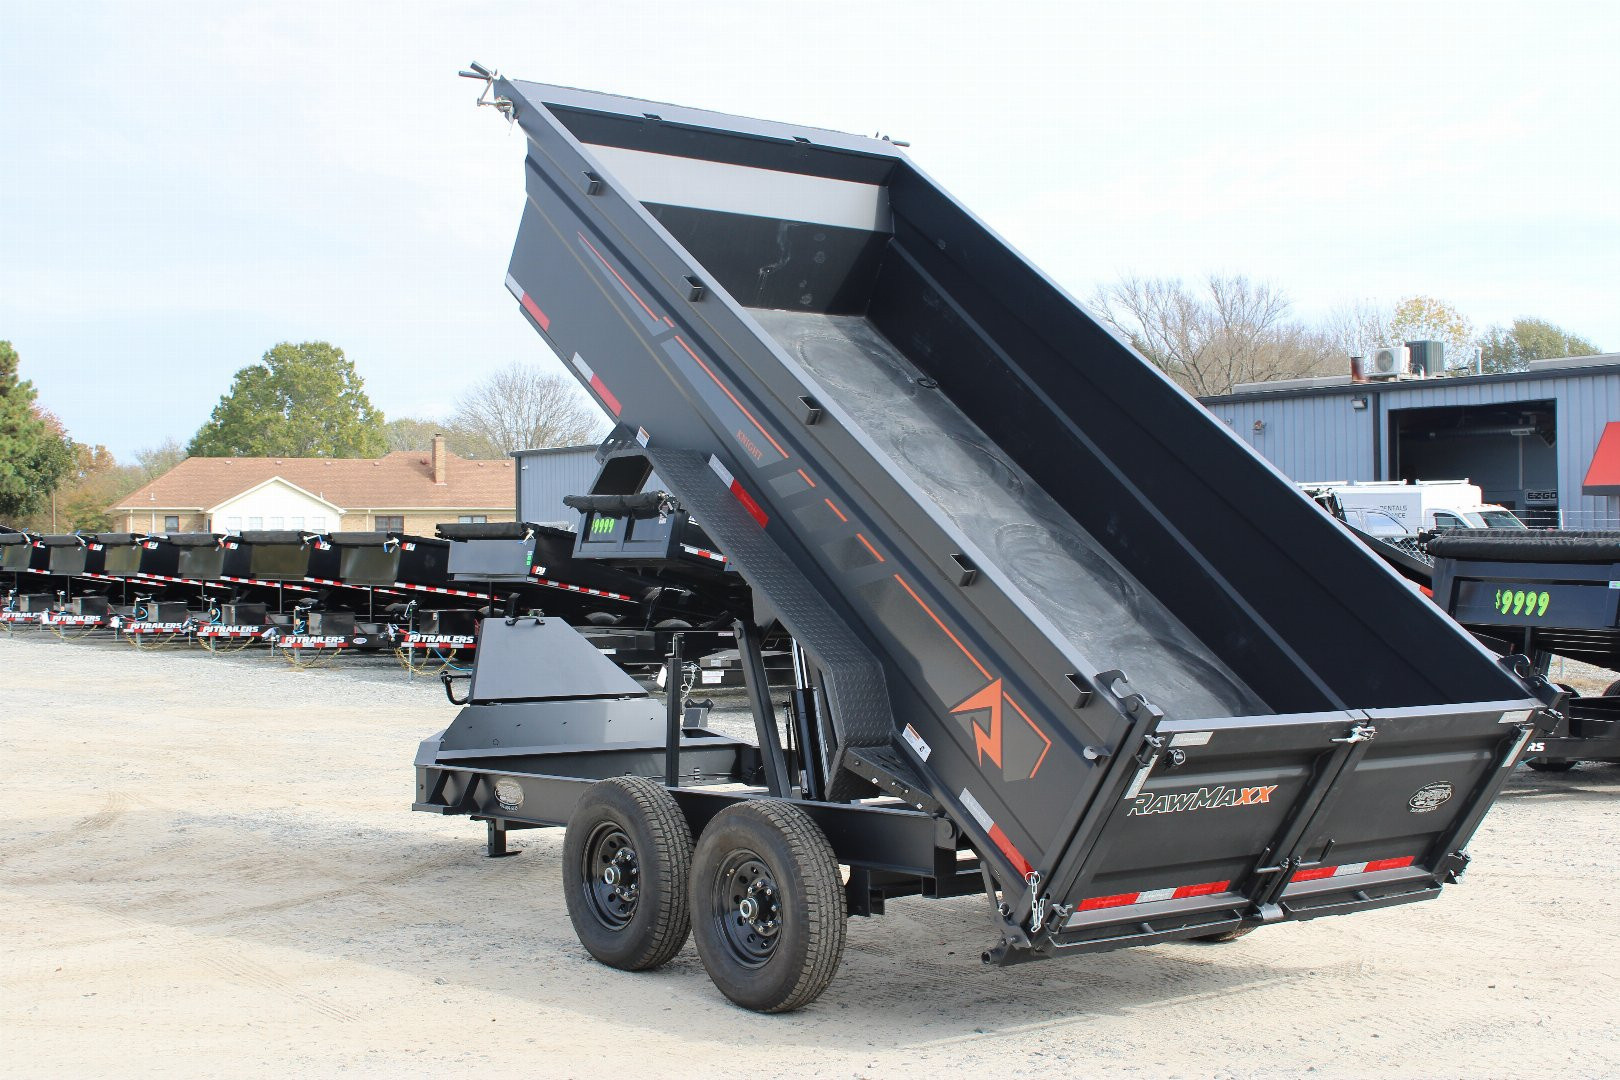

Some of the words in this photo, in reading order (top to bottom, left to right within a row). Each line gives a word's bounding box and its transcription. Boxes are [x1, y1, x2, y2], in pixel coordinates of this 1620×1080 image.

[1495, 589, 1550, 617] $9999
[296, 636, 345, 644] TRAILERS
[420, 635, 474, 644] TRAILERS
